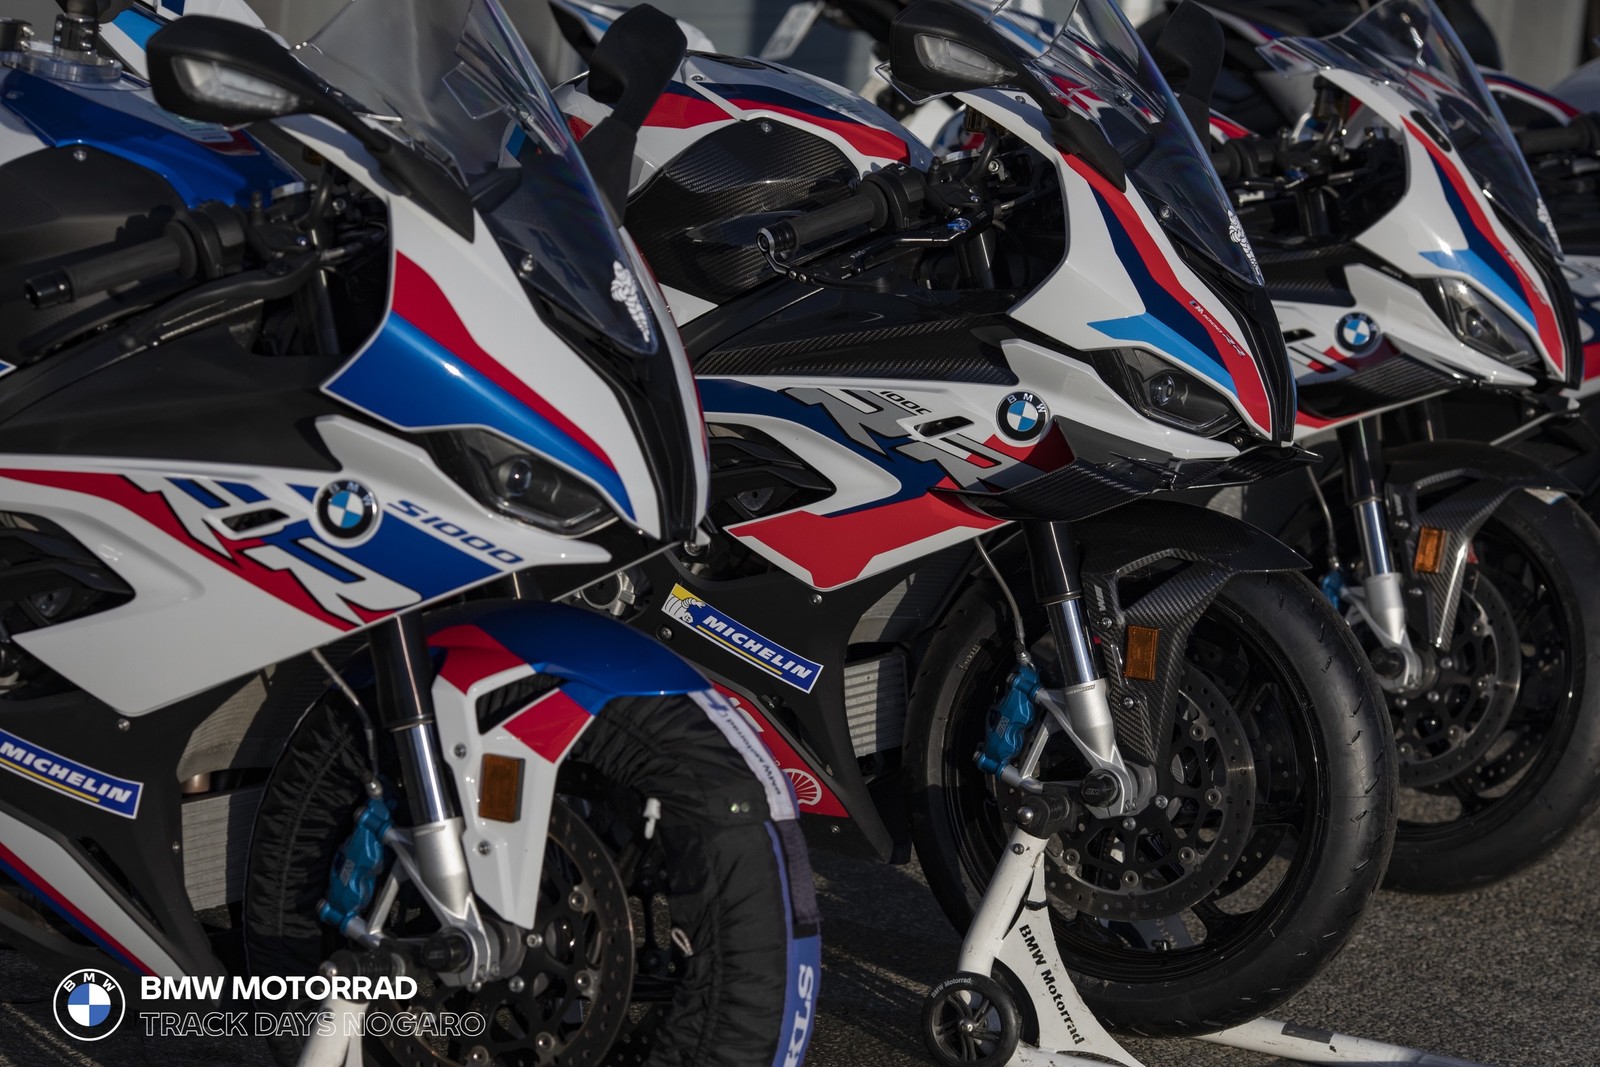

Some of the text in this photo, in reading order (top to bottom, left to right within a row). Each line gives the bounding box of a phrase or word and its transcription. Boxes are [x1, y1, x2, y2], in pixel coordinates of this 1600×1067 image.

[1007, 391, 1048, 414] BMW
[328, 481, 375, 508] BMW
[703, 615, 813, 680] MICHELIN
[0, 741, 132, 803] MICHELIN
[930, 977, 972, 999] BMW Motorrad
[1019, 924, 1085, 1045] BMW Motorrad
